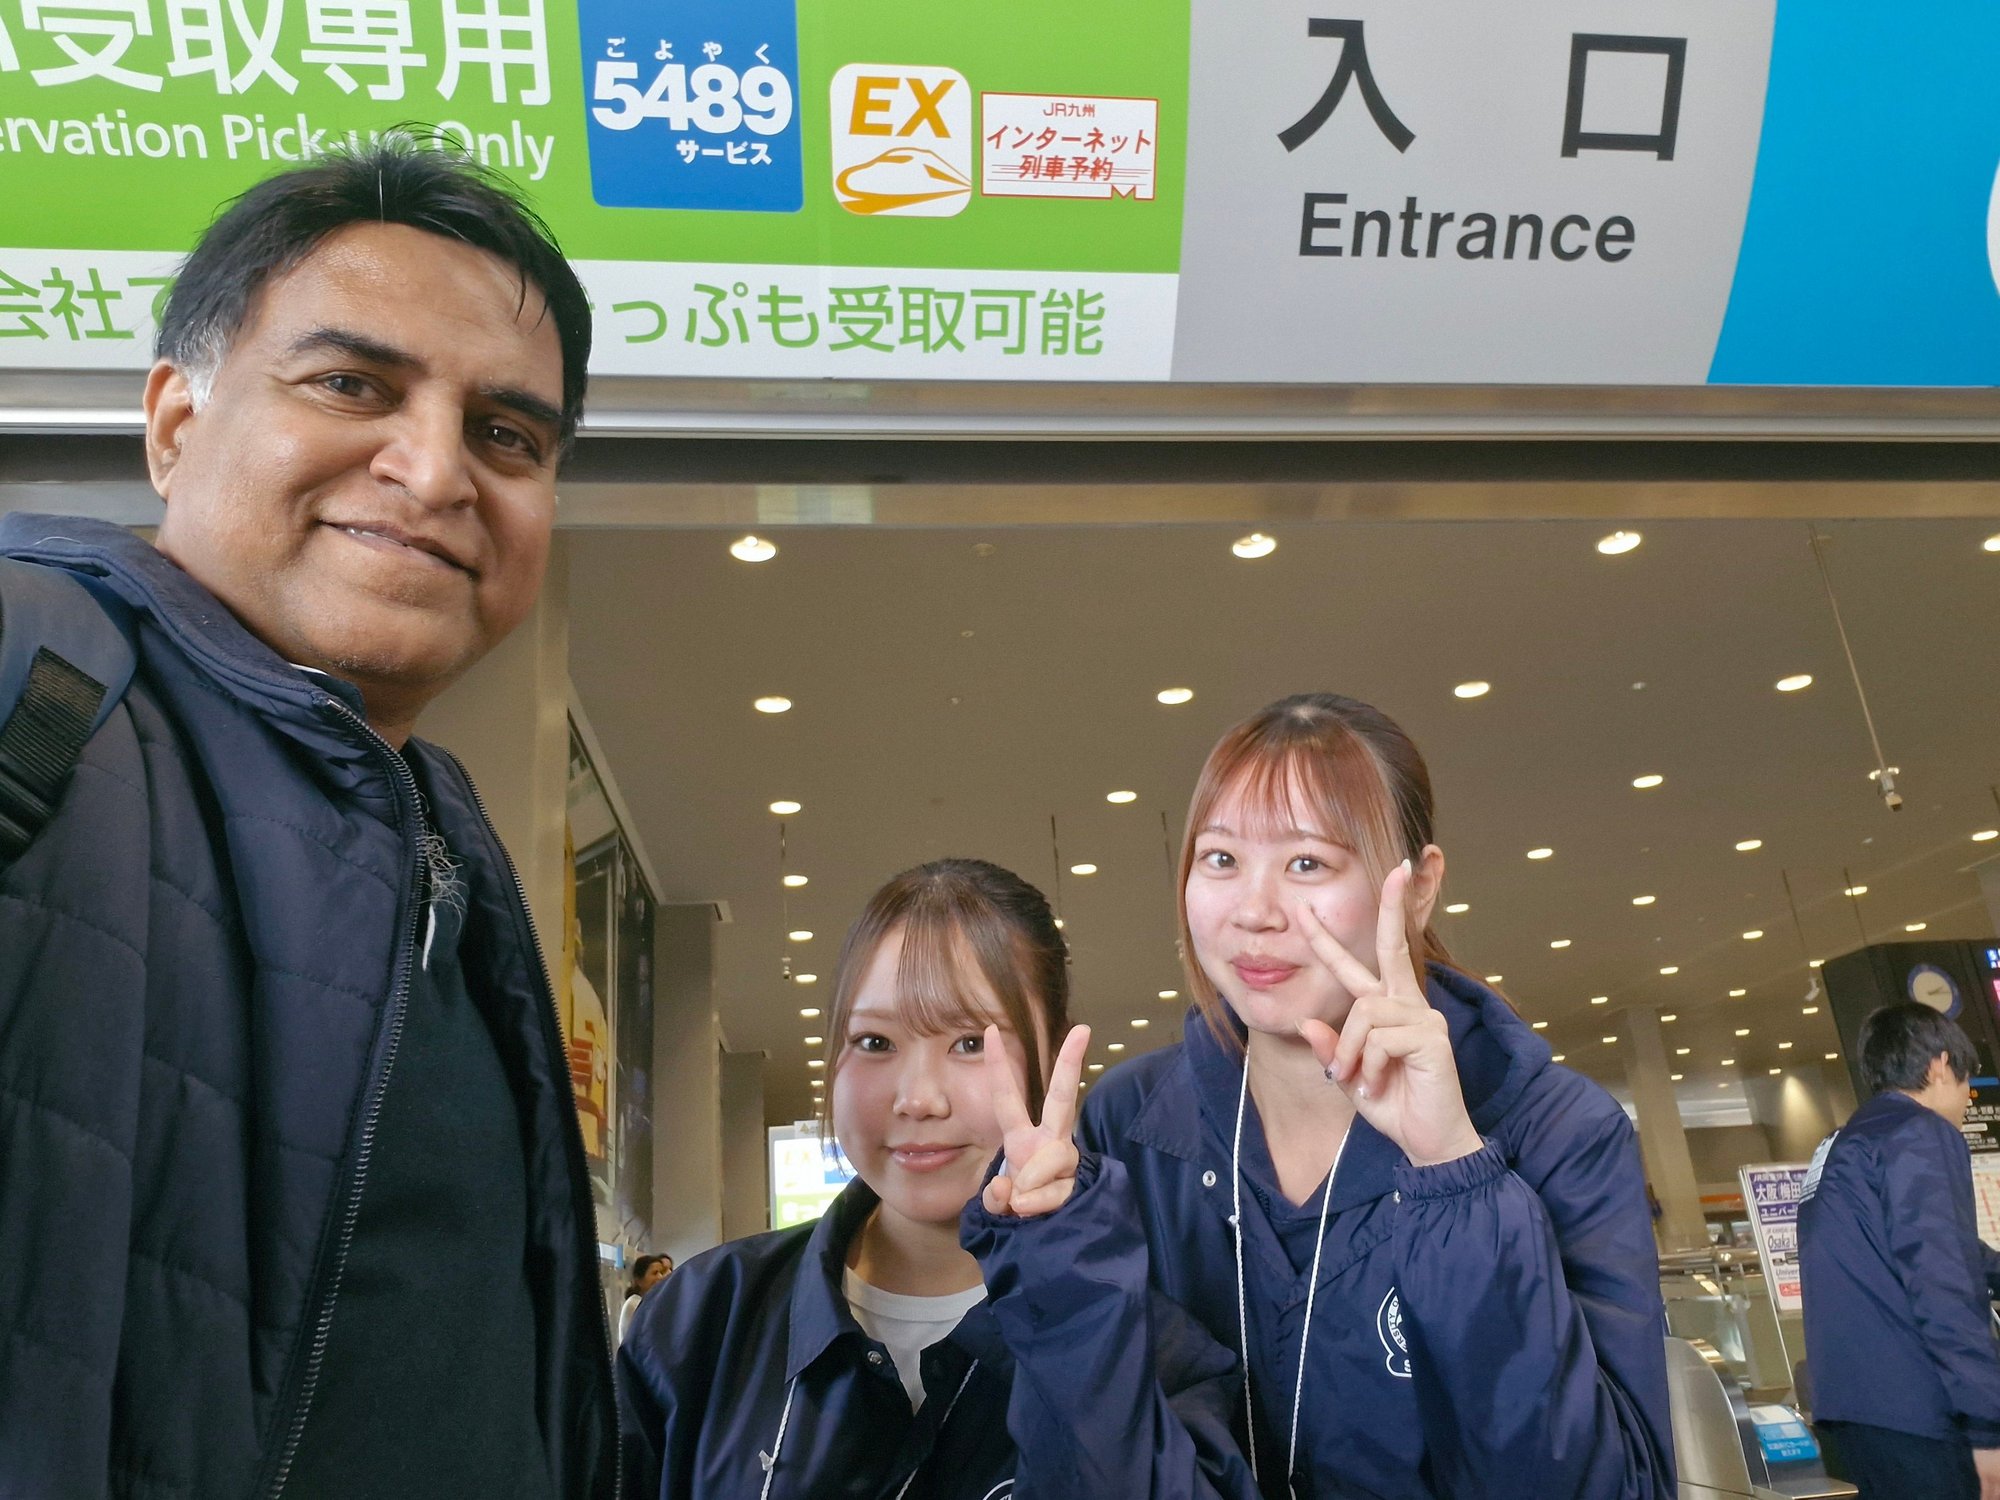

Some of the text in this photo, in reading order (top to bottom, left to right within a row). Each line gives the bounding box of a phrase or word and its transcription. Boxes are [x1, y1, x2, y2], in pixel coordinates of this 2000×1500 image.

[592, 61, 793, 136] 5489
[849, 76, 957, 138] EX
[1043, 102, 1096, 118] JR九州
[1277, 18, 1687, 161] 入口
[676, 139, 772, 165] サービス
[986, 124, 1152, 155] インターネット
[1018, 154, 1114, 182] 列車予約
[1299, 192, 1636, 263] Entrance
